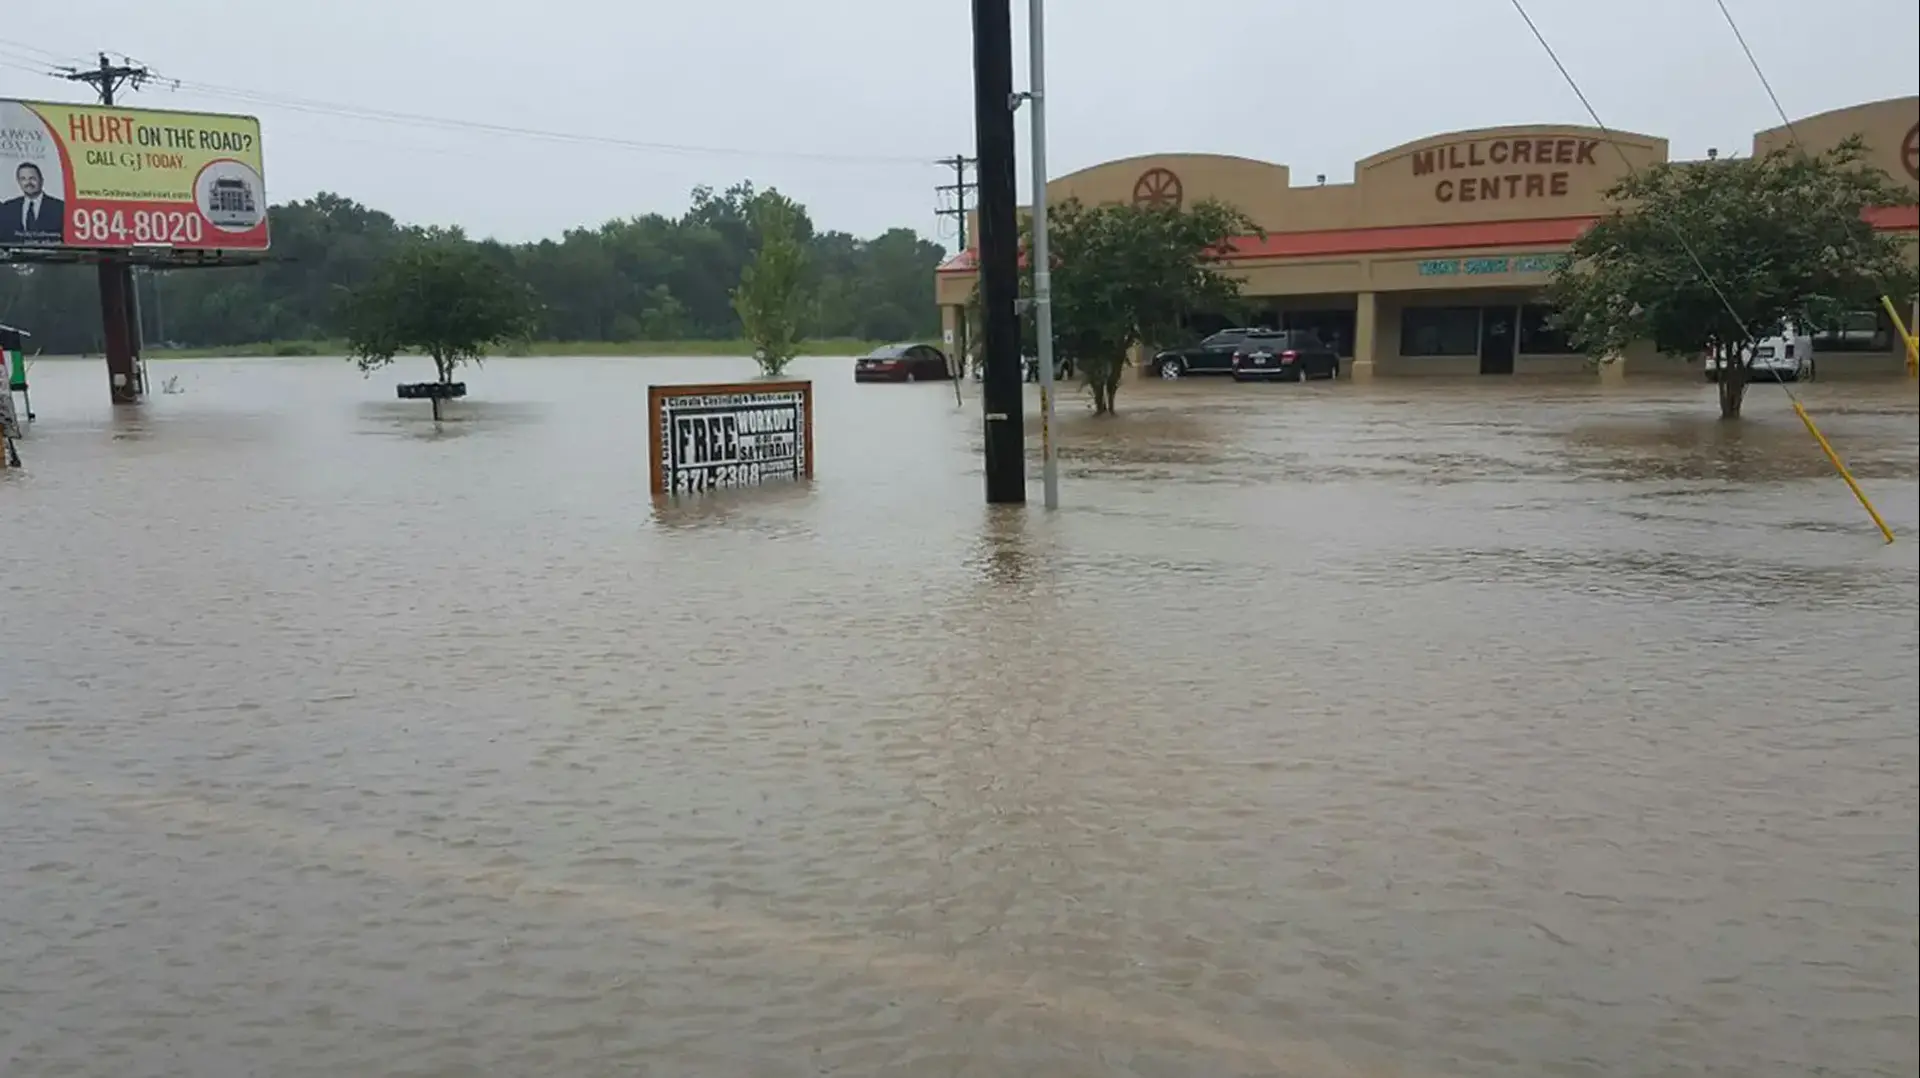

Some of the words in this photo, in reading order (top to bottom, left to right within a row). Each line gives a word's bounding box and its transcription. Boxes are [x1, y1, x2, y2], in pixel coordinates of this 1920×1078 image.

[68, 113, 134, 145] HURT
[138, 126, 162, 147] ON
[164, 127, 195, 149] THE
[200, 131, 253, 152] ROAD?
[87, 150, 115, 166] CALL
[1412, 139, 1600, 176] MILLCREEK
[1435, 171, 1569, 203] CENTRE
[73, 208, 202, 242] 984-8020
[677, 415, 738, 464] FREE
[737, 408, 795, 433] WORKOUT
[739, 442, 794, 460] SATURDAY
[676, 463, 760, 492] 371-2308
